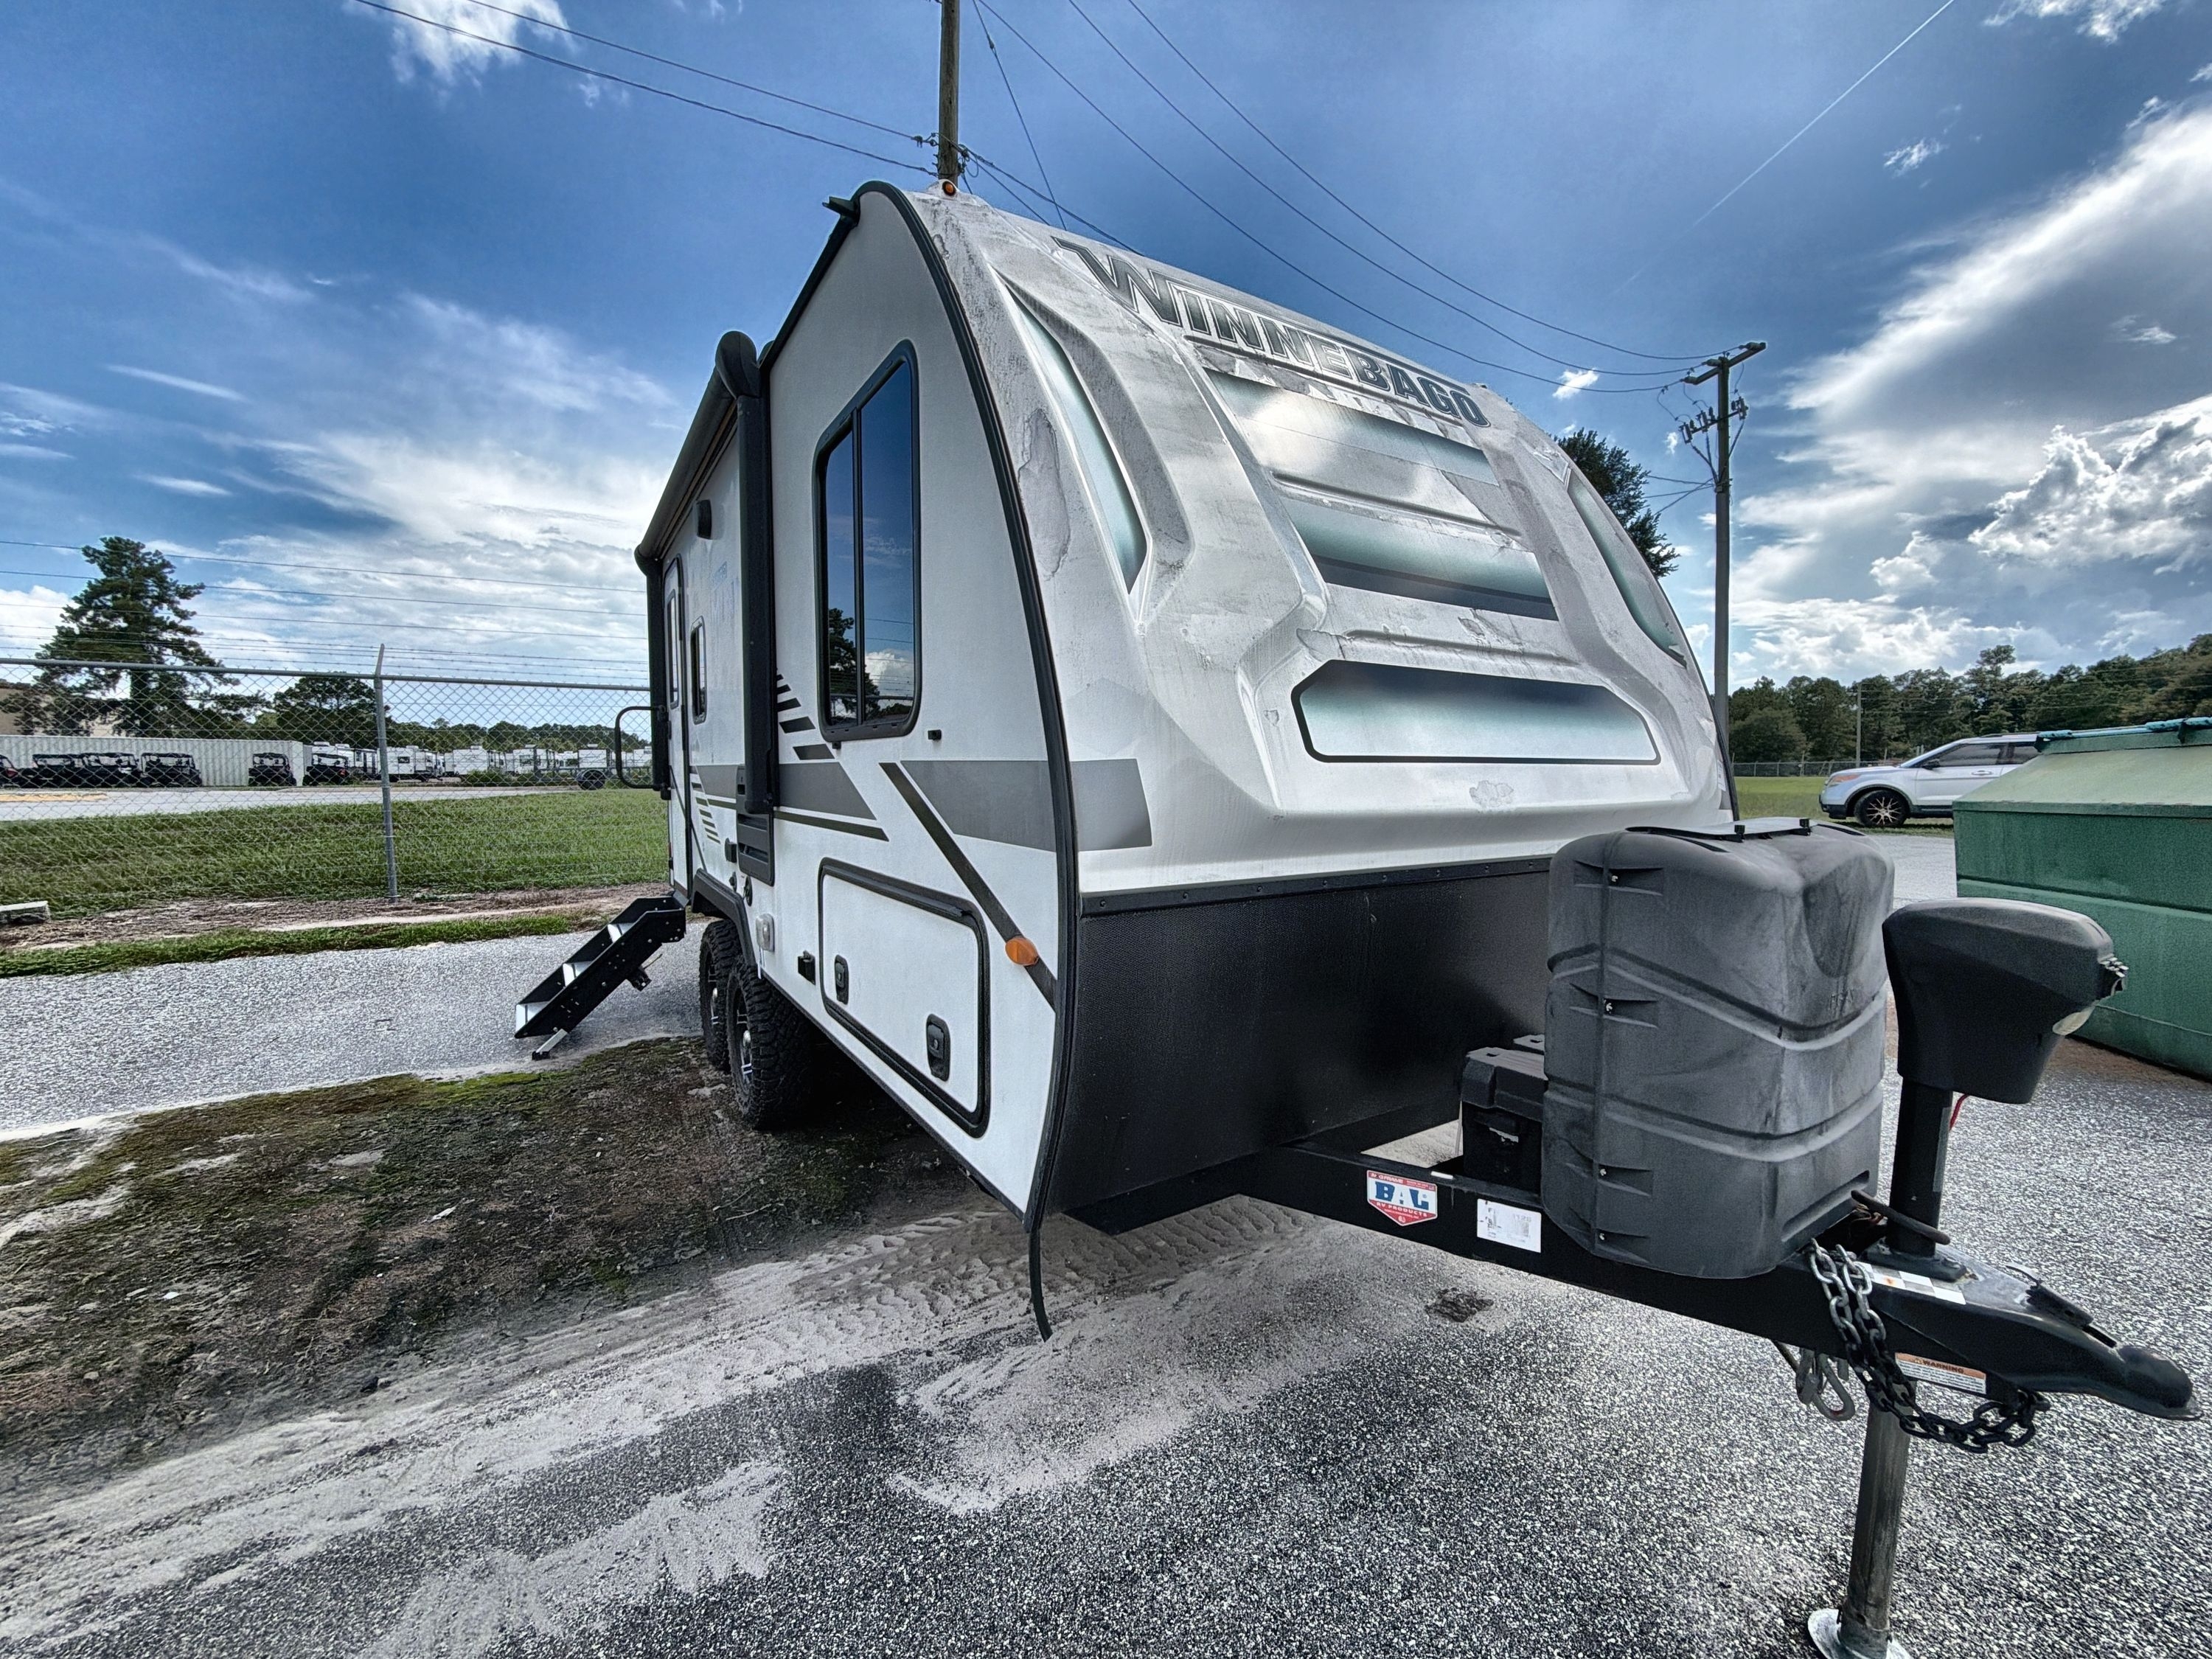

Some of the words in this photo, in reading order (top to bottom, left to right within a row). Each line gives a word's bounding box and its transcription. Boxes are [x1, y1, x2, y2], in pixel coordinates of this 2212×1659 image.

[1050, 235, 1492, 428] WINNEBAGO
[1374, 1181, 1429, 1210] BAL
[1388, 1205, 1427, 1217] PRODUCTS
[1923, 1360, 1964, 1374] WARNING
